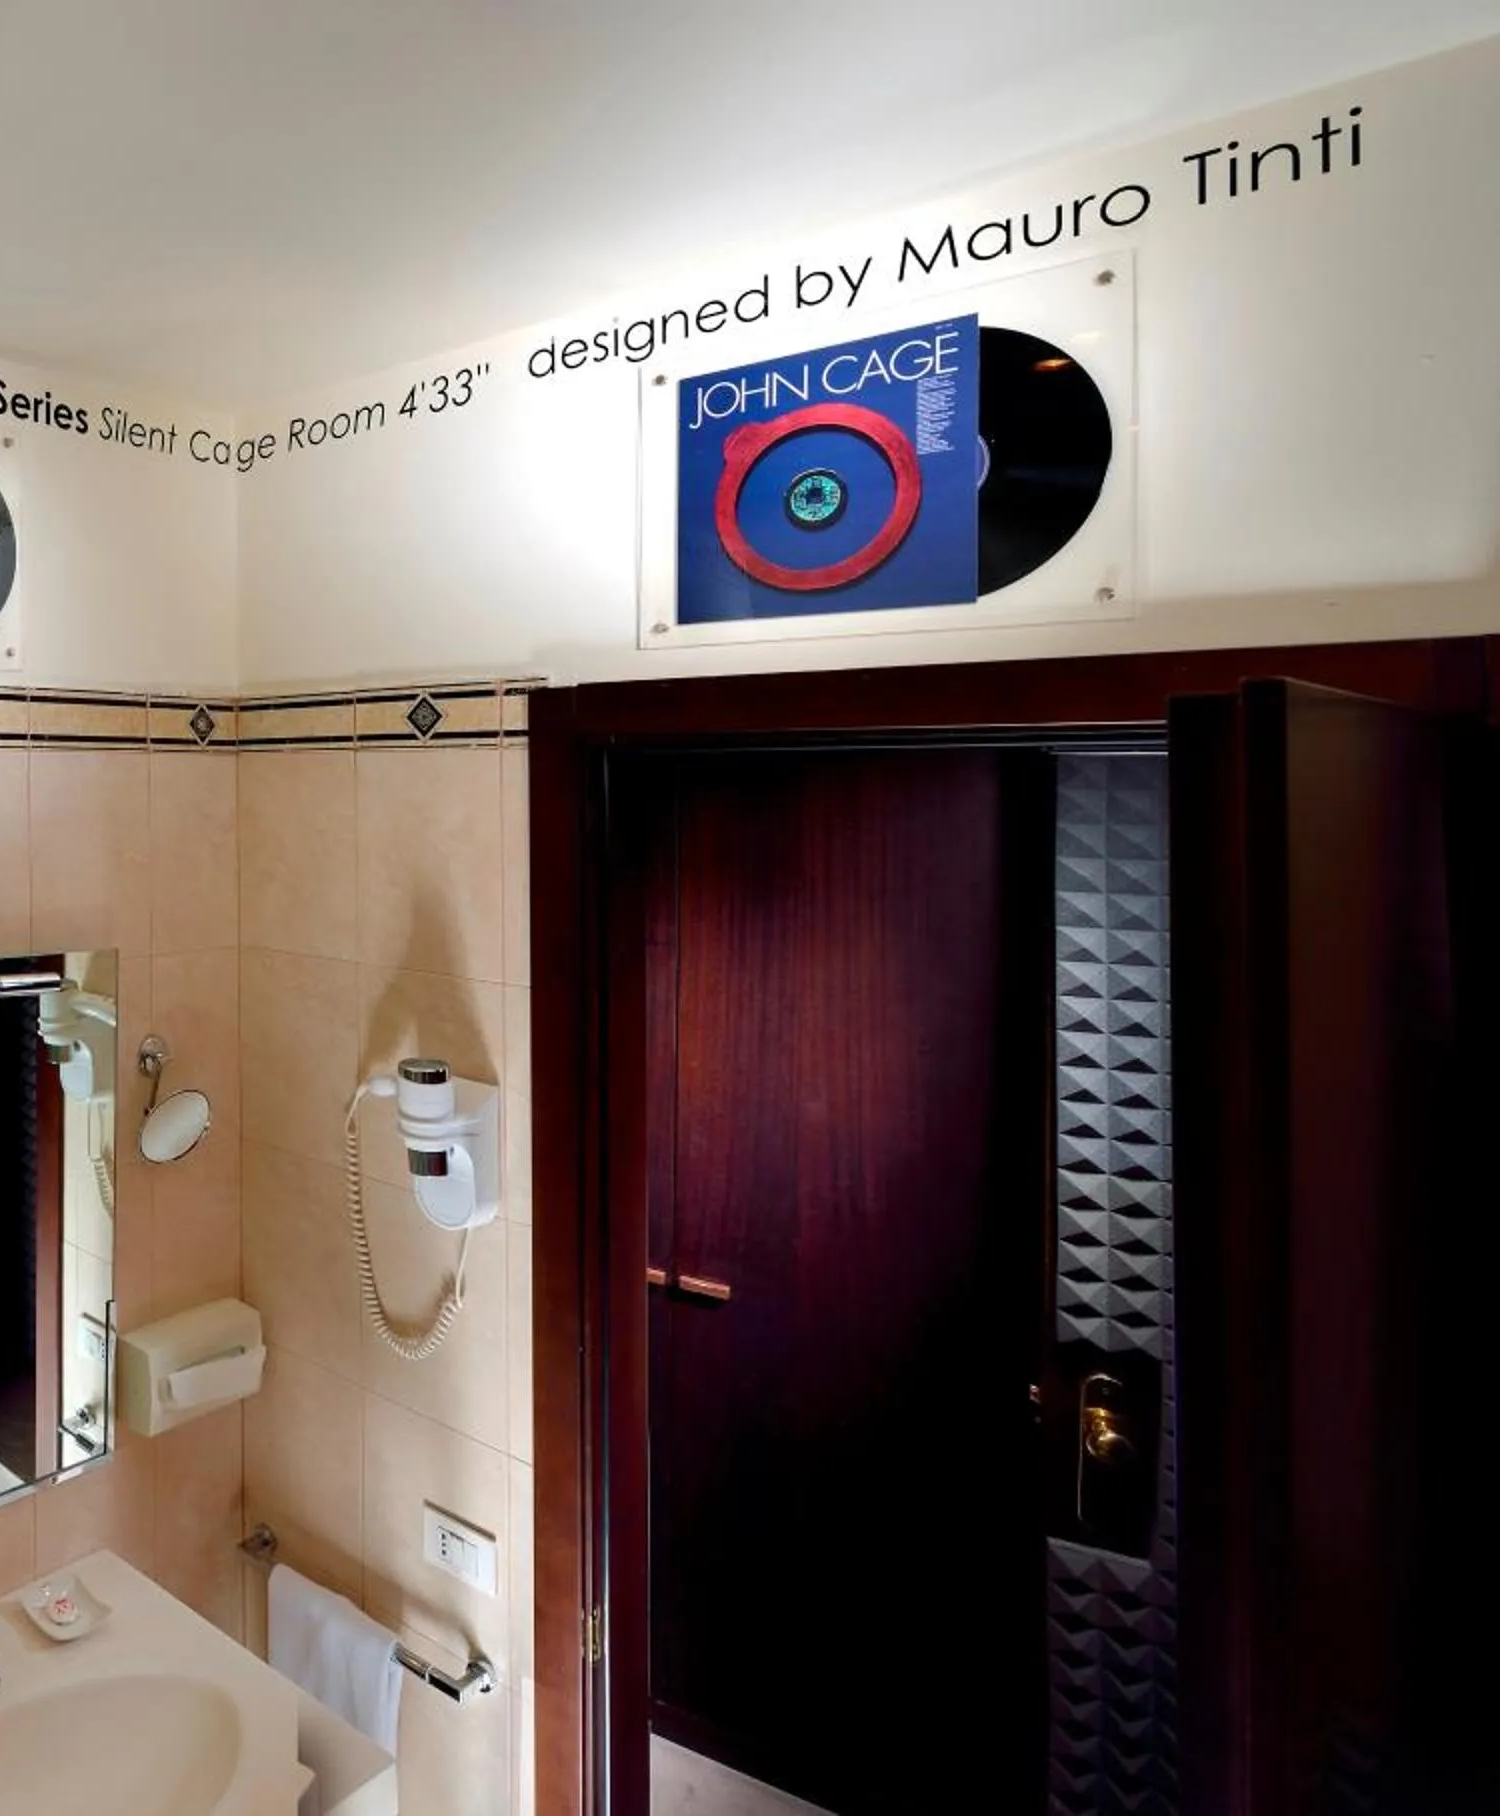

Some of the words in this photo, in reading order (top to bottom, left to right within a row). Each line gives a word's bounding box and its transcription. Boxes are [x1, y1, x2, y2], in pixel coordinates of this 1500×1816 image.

[99, 406, 177, 455] Silent
[189, 430, 276, 473] Cage
[287, 402, 386, 453] Room
[527, 275, 770, 379] designed
[794, 255, 873, 312] by
[898, 180, 1152, 283] Mauro
[1183, 106, 1363, 206] Tinti
[689, 364, 810, 430] JOHN
[821, 331, 960, 395] CAGE
